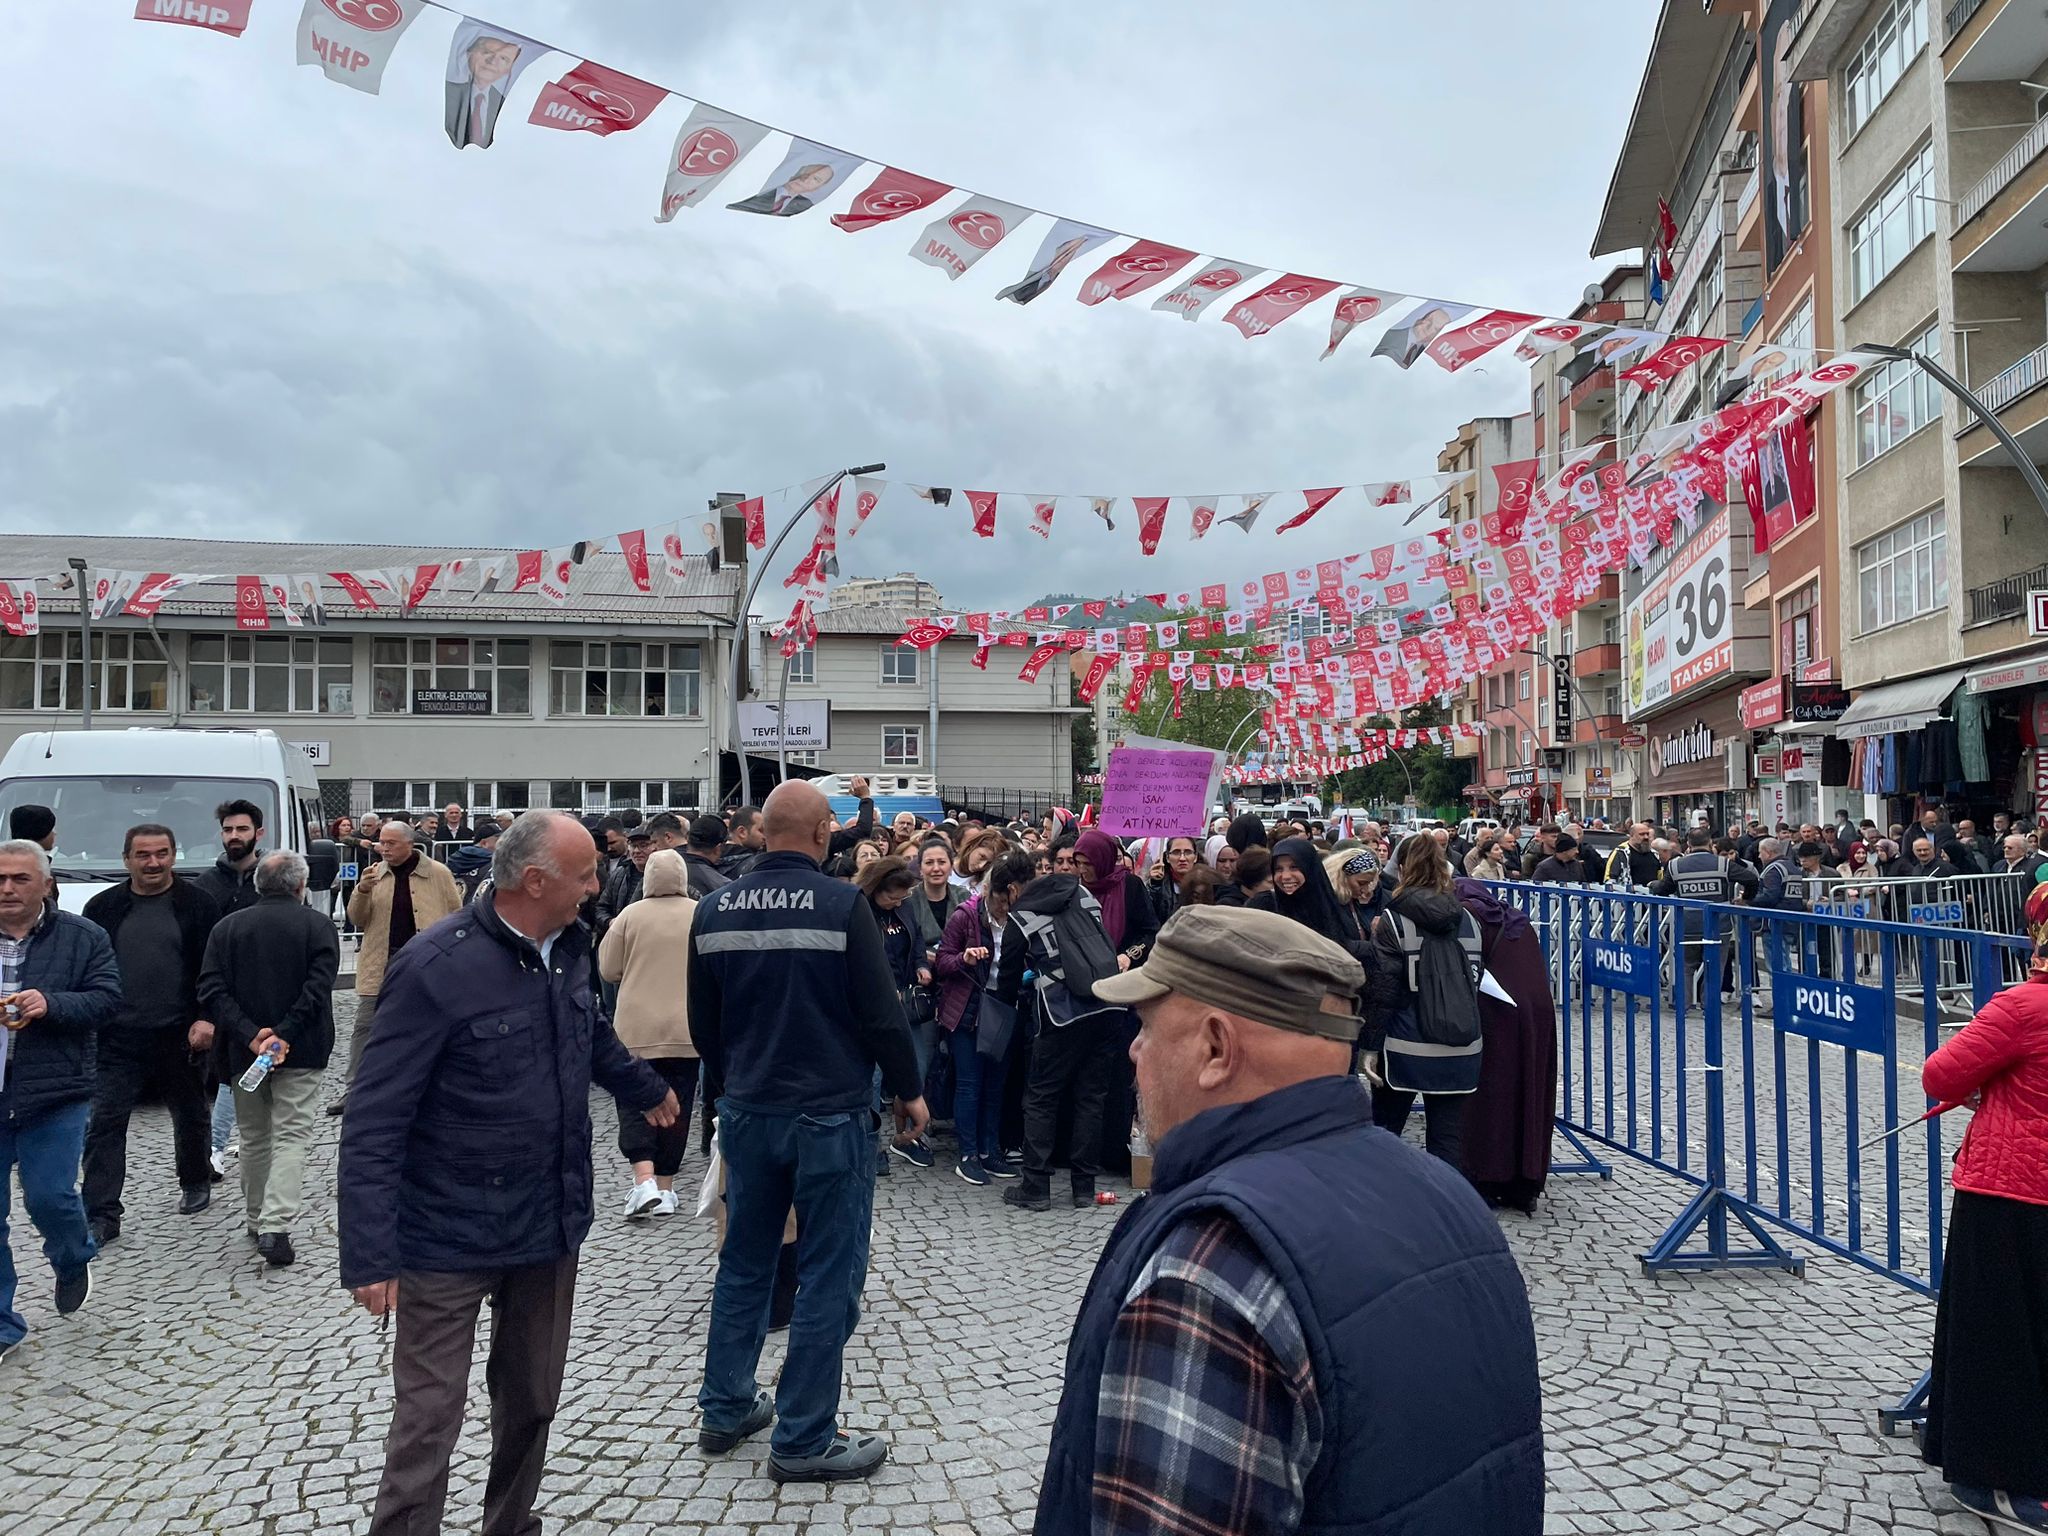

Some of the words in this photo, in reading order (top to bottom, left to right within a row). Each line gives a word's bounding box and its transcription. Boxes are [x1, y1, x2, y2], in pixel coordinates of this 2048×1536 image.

[154, 0, 230, 26] MHP
[312, 30, 370, 73] MHP
[924, 239, 967, 273] MHP
[541, 583, 565, 600] MHP
[1675, 556, 1727, 657] 36
[1673, 646, 1732, 688] TAKSİT
[1981, 669, 2025, 687] HASTANELER
[1555, 658, 1569, 717] OTEL
[788, 724, 811, 735] İLERİ
[1662, 719, 1712, 768] gündoğdu
[1761, 759, 1775, 773] E
[717, 888, 815, 912] S.AKKAYA
[1596, 946, 1633, 974] POLİS
[1796, 985, 1856, 1022] POLİS
